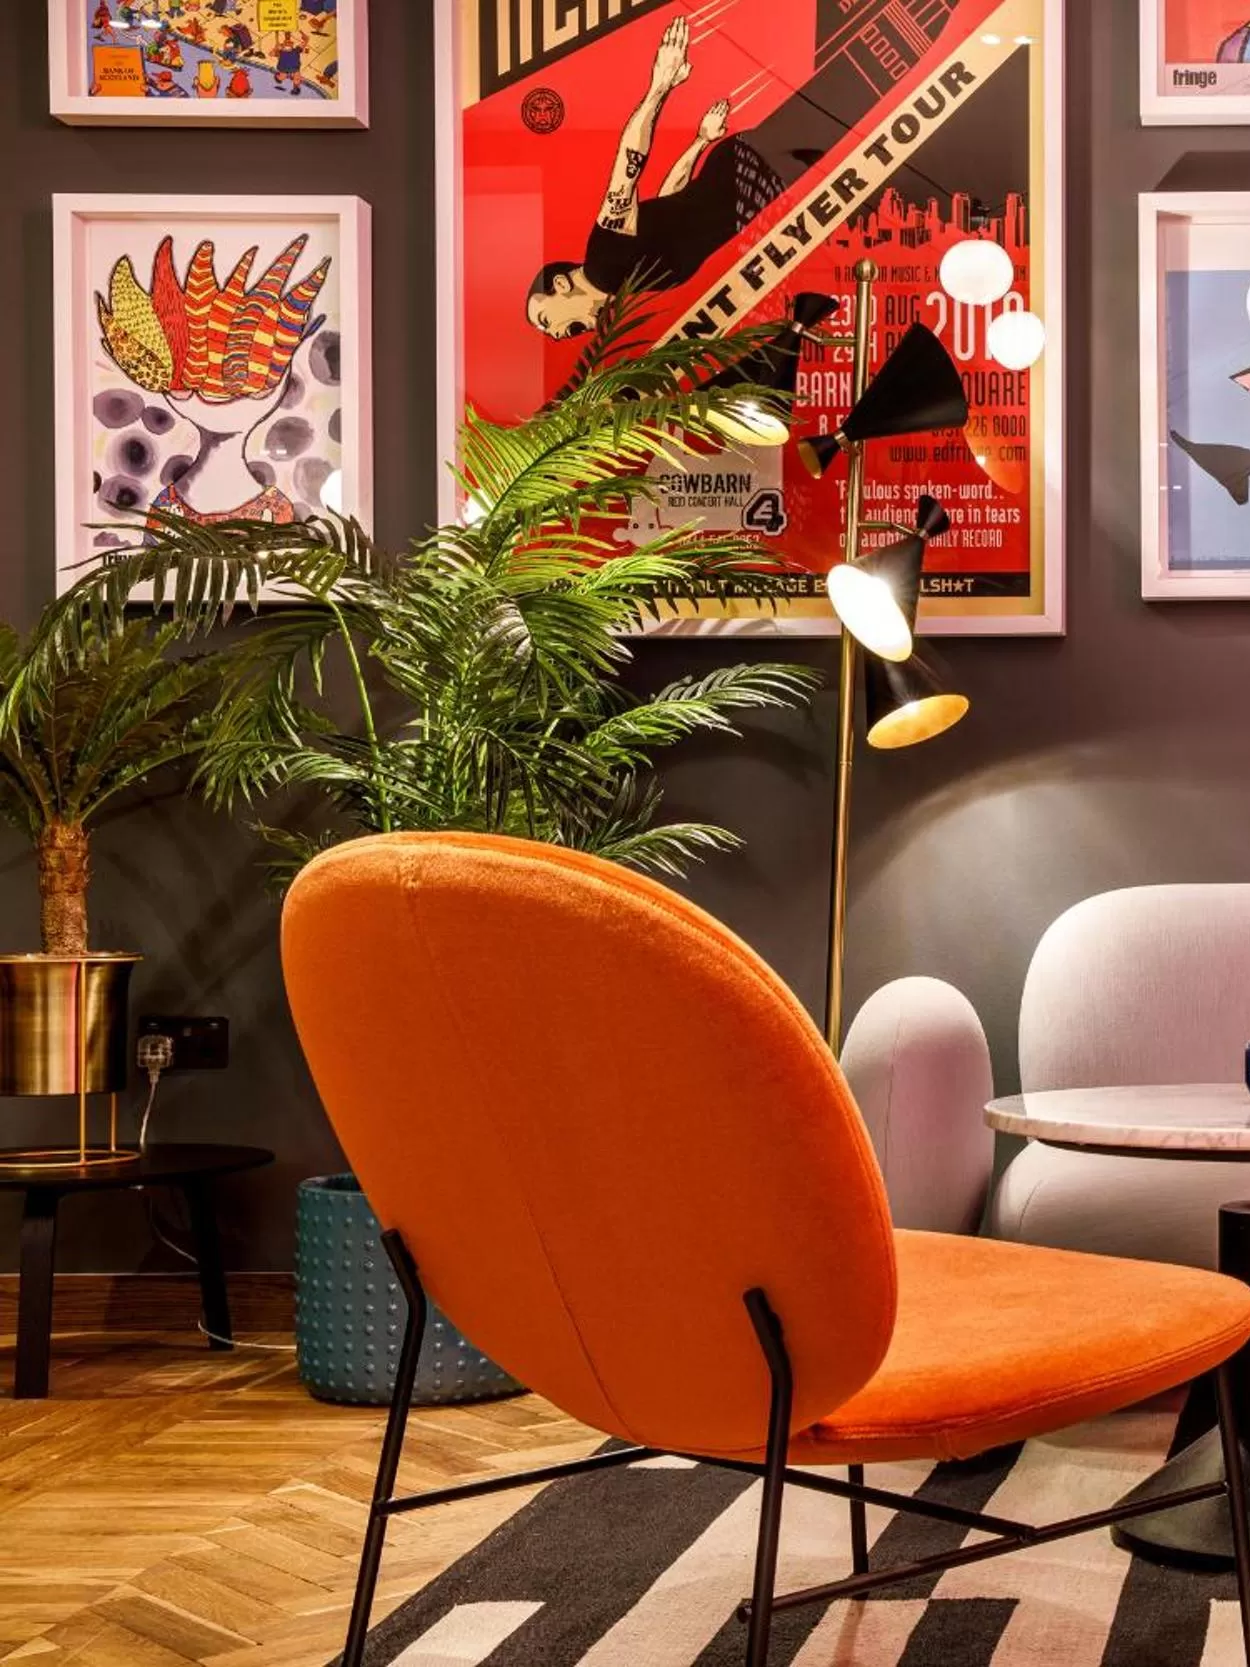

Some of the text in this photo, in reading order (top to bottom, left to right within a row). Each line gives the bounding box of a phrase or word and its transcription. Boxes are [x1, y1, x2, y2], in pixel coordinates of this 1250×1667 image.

[1172, 68, 1218, 89] fringe
[739, 167, 868, 291] FLYER
[863, 61, 976, 168] TOUR
[961, 371, 1026, 408] QUARE
[835, 479, 900, 500] 'Fulous
[967, 504, 981, 523] in
[985, 505, 1021, 524] tears
[962, 529, 1003, 548] RECORD
